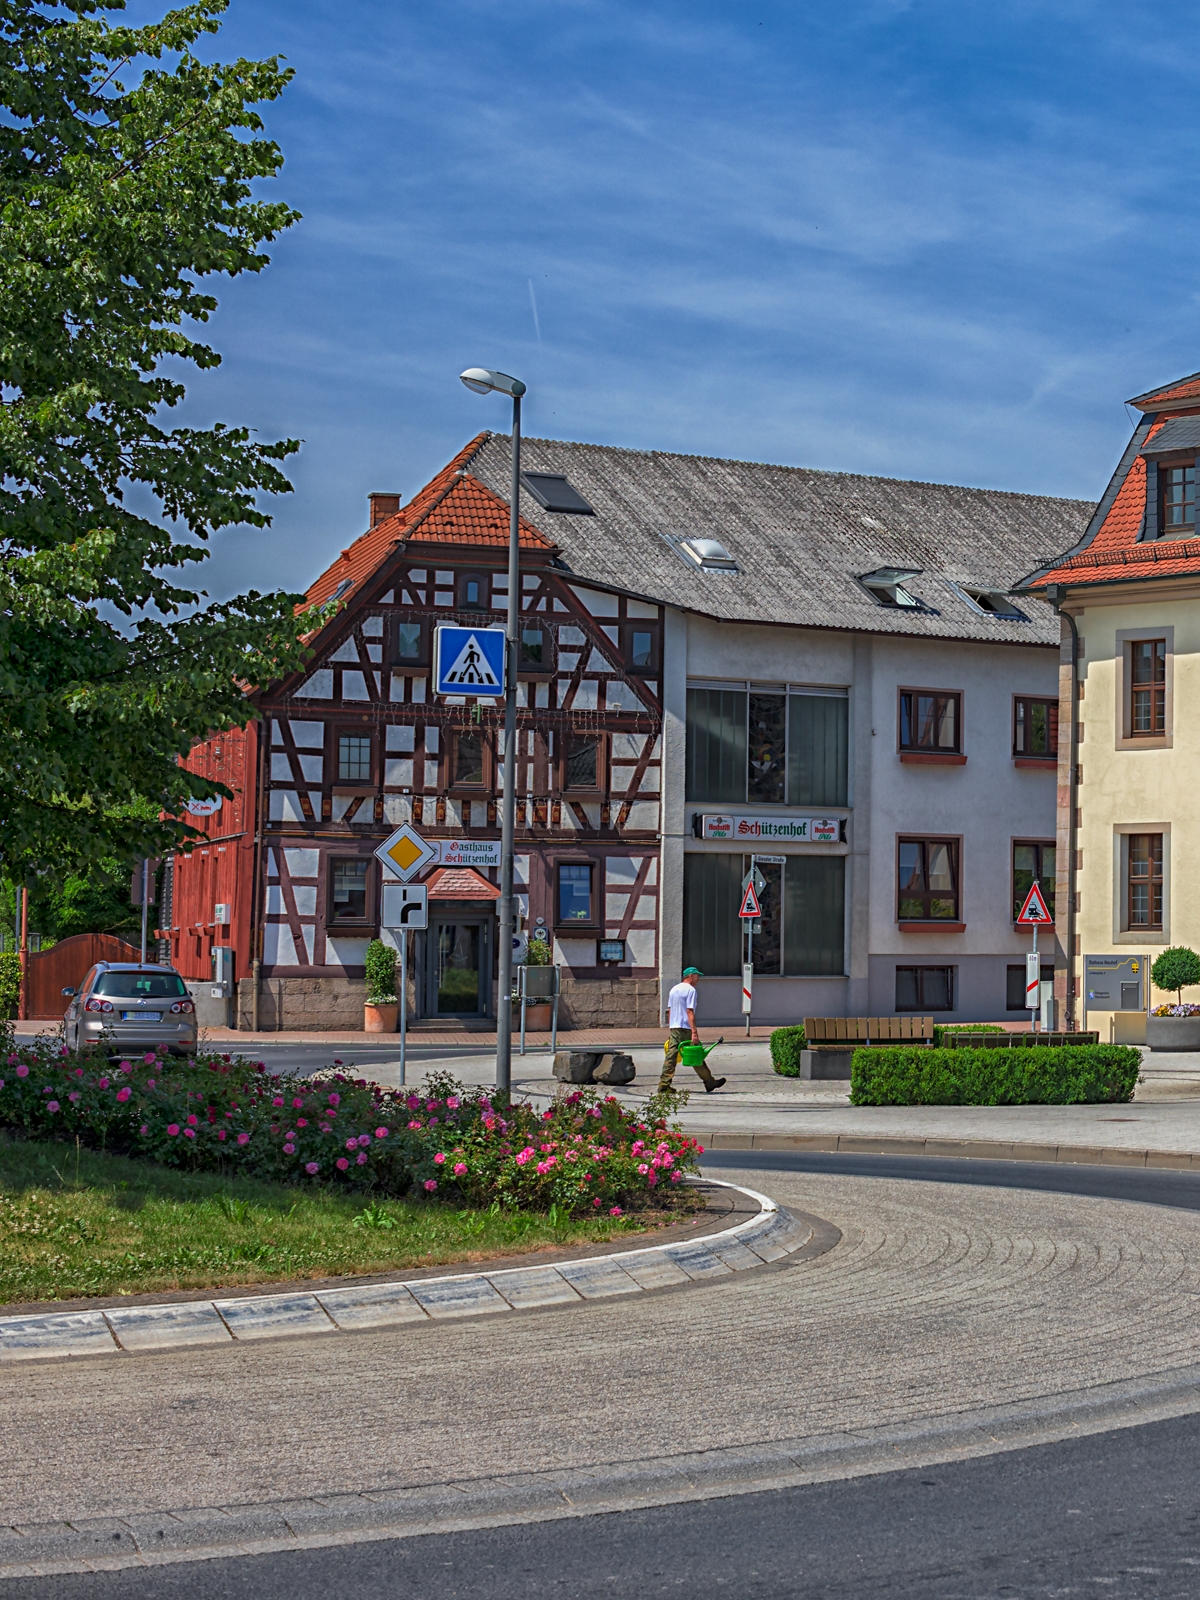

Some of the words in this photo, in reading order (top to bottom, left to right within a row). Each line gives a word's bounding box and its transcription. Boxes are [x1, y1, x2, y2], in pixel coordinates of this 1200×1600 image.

[738, 820, 807, 838] Schützenhof
[450, 842, 493, 853] Gasthaus
[444, 853, 498, 864] Schützenhof
